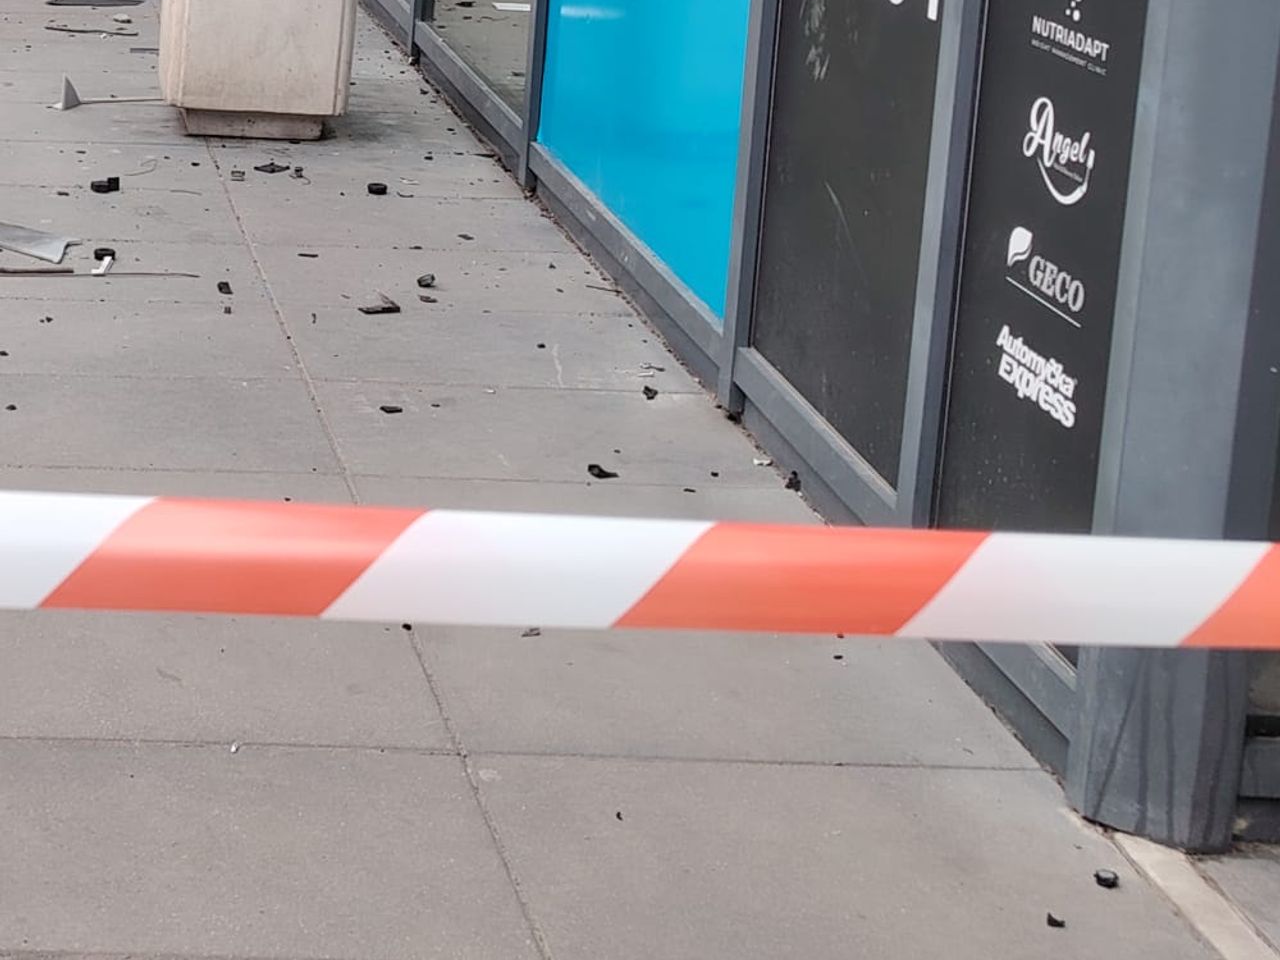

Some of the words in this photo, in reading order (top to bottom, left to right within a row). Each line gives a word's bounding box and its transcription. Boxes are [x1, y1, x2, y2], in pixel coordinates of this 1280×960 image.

[1032, 15, 1110, 62] NUTRIADAPT
[1028, 255, 1086, 313] GECO
[996, 324, 1076, 399] Automyčka
[998, 352, 1077, 428] Express
